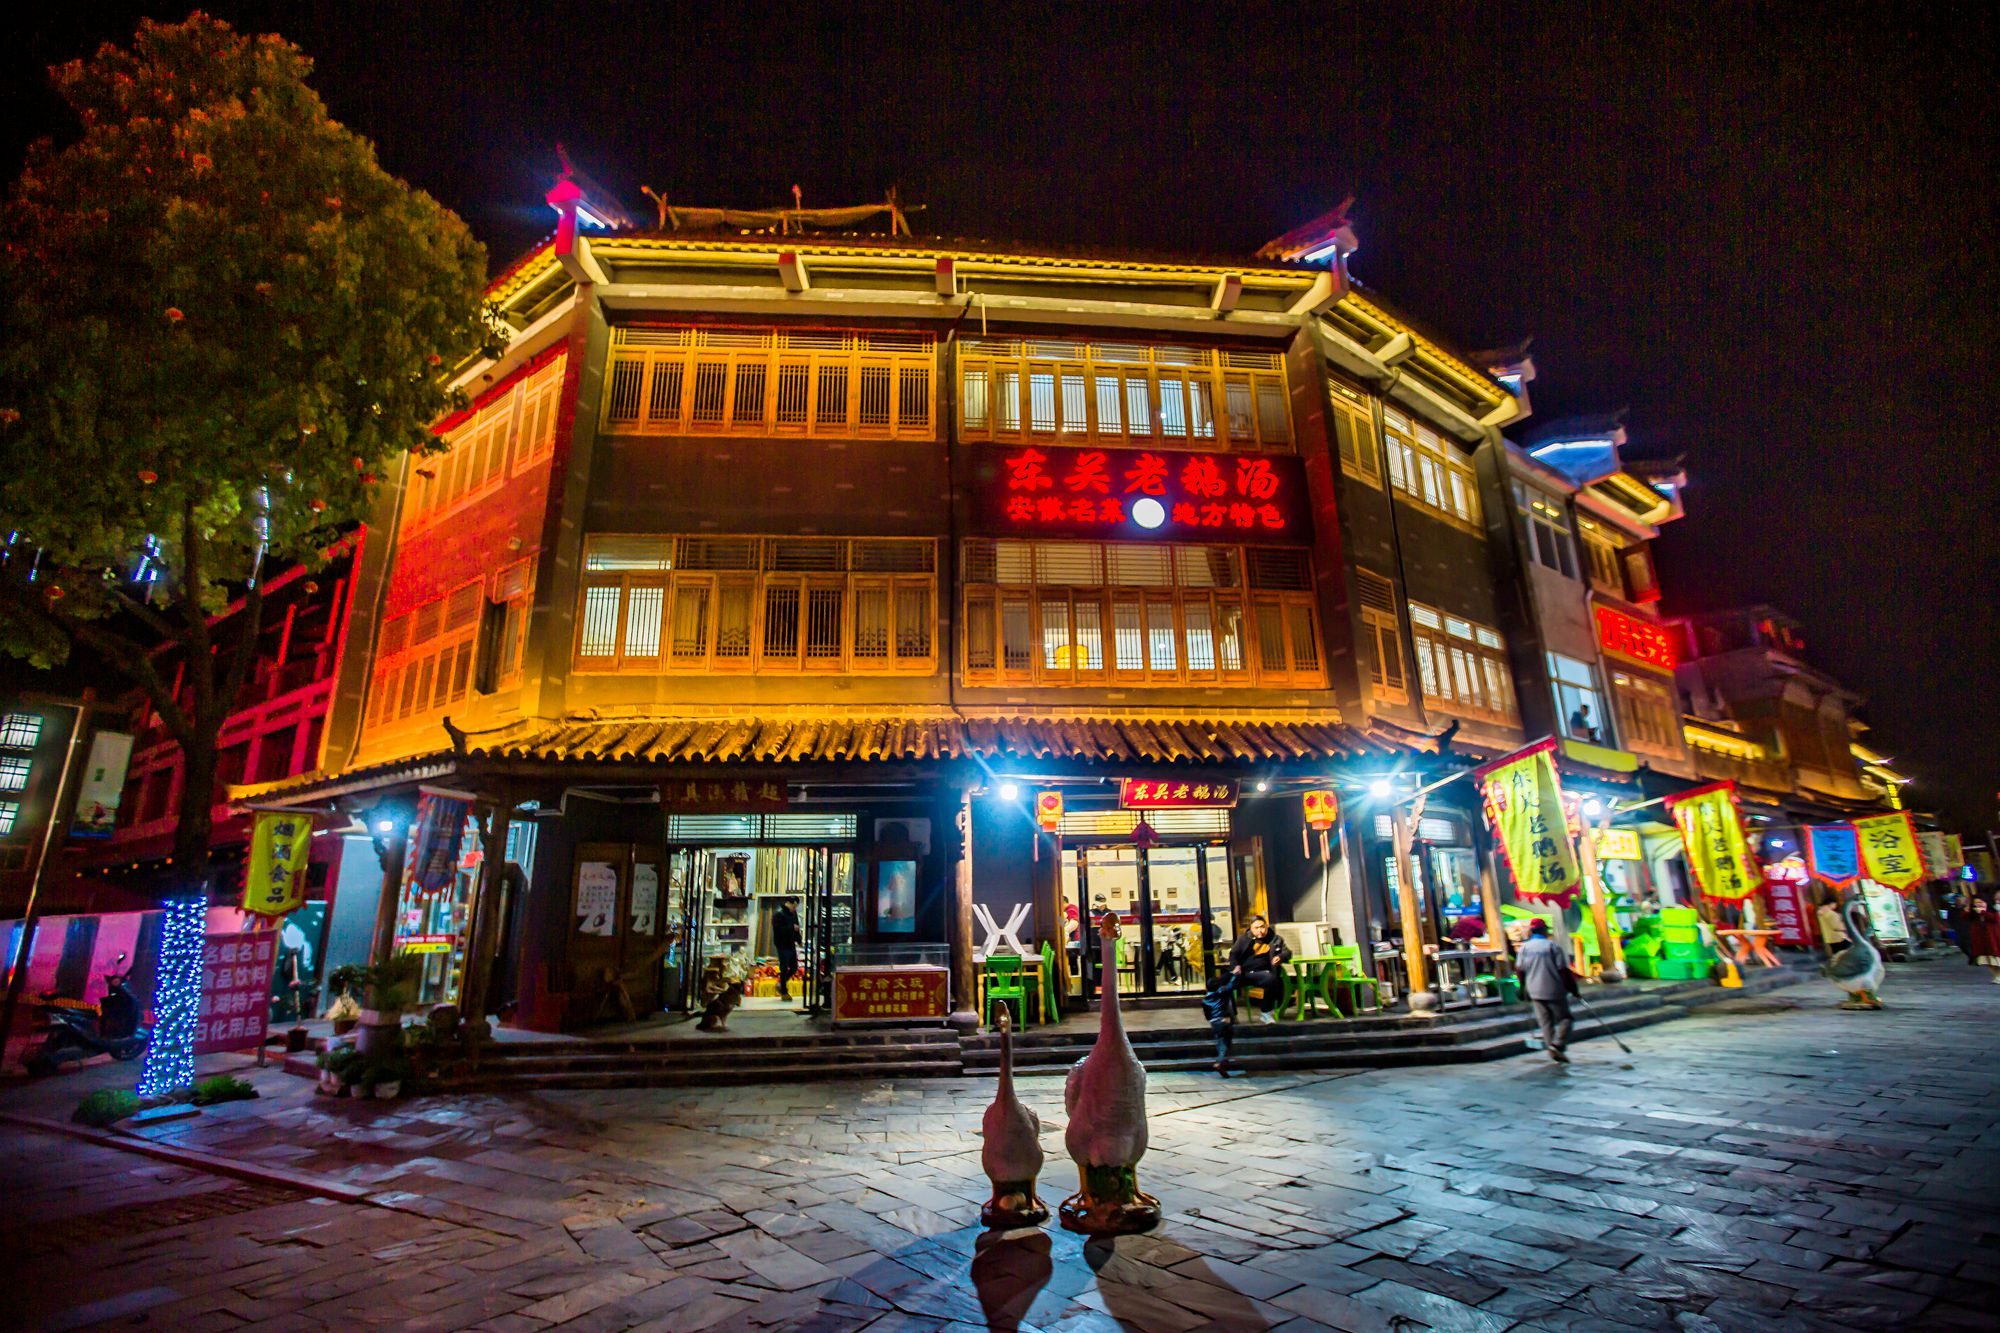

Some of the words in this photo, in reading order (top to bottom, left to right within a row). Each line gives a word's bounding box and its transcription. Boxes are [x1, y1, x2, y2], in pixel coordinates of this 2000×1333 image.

[1006, 449, 1280, 498] 东关老鹅汤
[1007, 495, 1127, 523] 安徽名菜
[1172, 502, 1285, 529] 地方特色
[1868, 829, 1912, 875] 浴室
